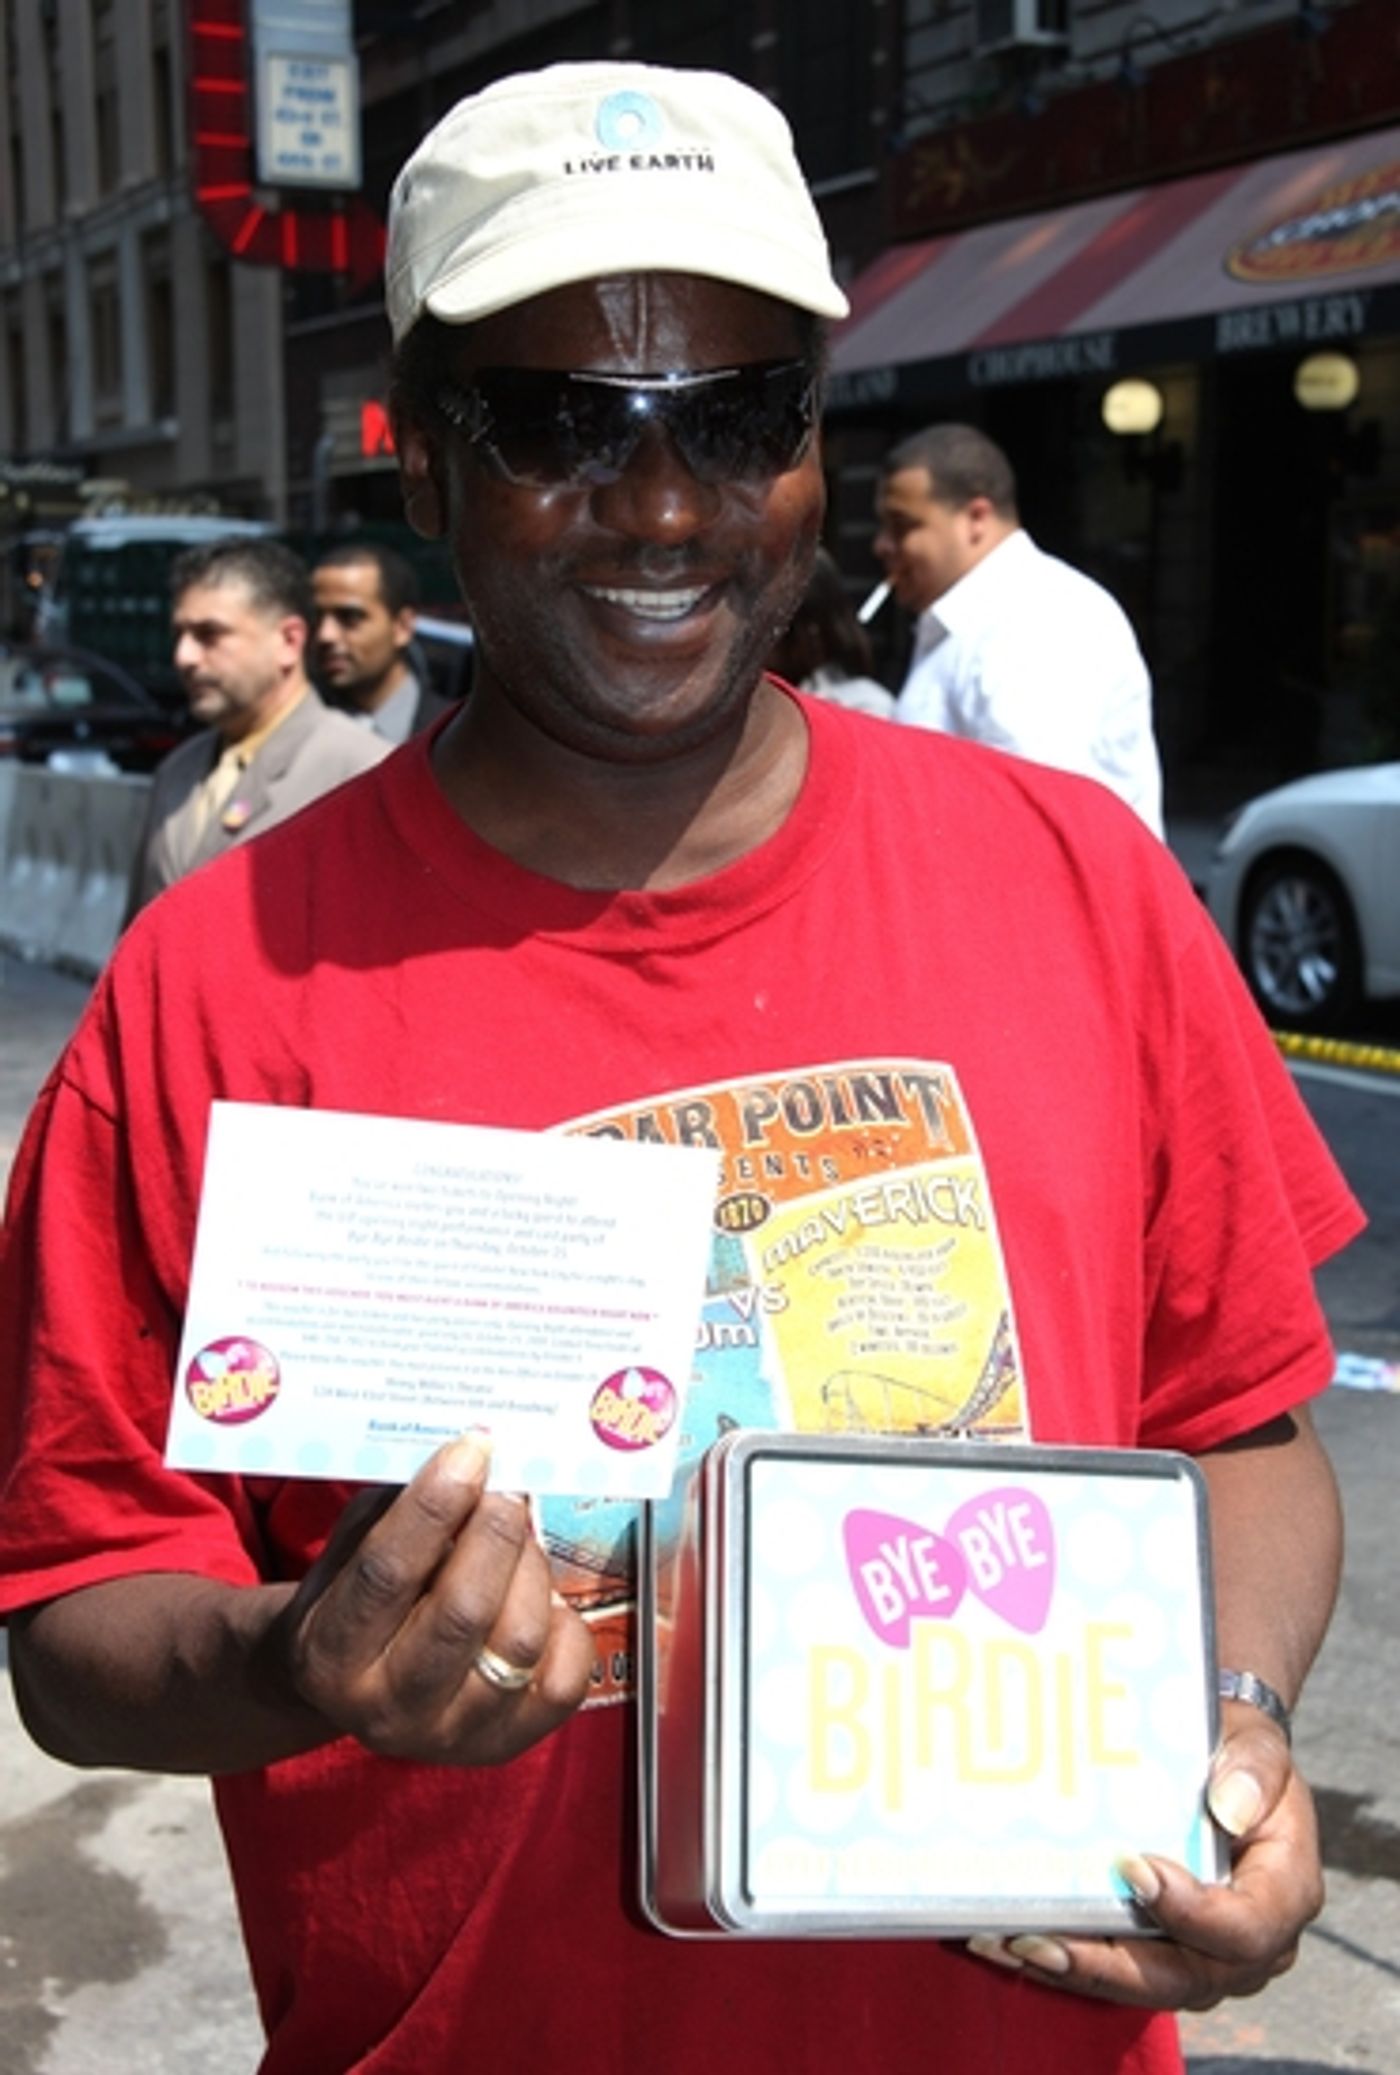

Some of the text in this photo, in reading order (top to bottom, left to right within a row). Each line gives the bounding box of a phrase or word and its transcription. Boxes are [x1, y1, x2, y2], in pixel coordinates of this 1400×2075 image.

[563, 154, 716, 175] LIVE EARTH
[966, 335, 1121, 386] CHOPHOUSE
[1215, 295, 1368, 350] BREWERY
[739, 1072, 950, 1152] POINT
[763, 1177, 987, 1272] MAVERICK
[728, 1281, 790, 1322] VS
[368, 1419, 397, 1431] Bank
[414, 1422, 461, 1436] America
[859, 1501, 1047, 1626] BYE BYE
[808, 1619, 1146, 1814] BIRDIE
